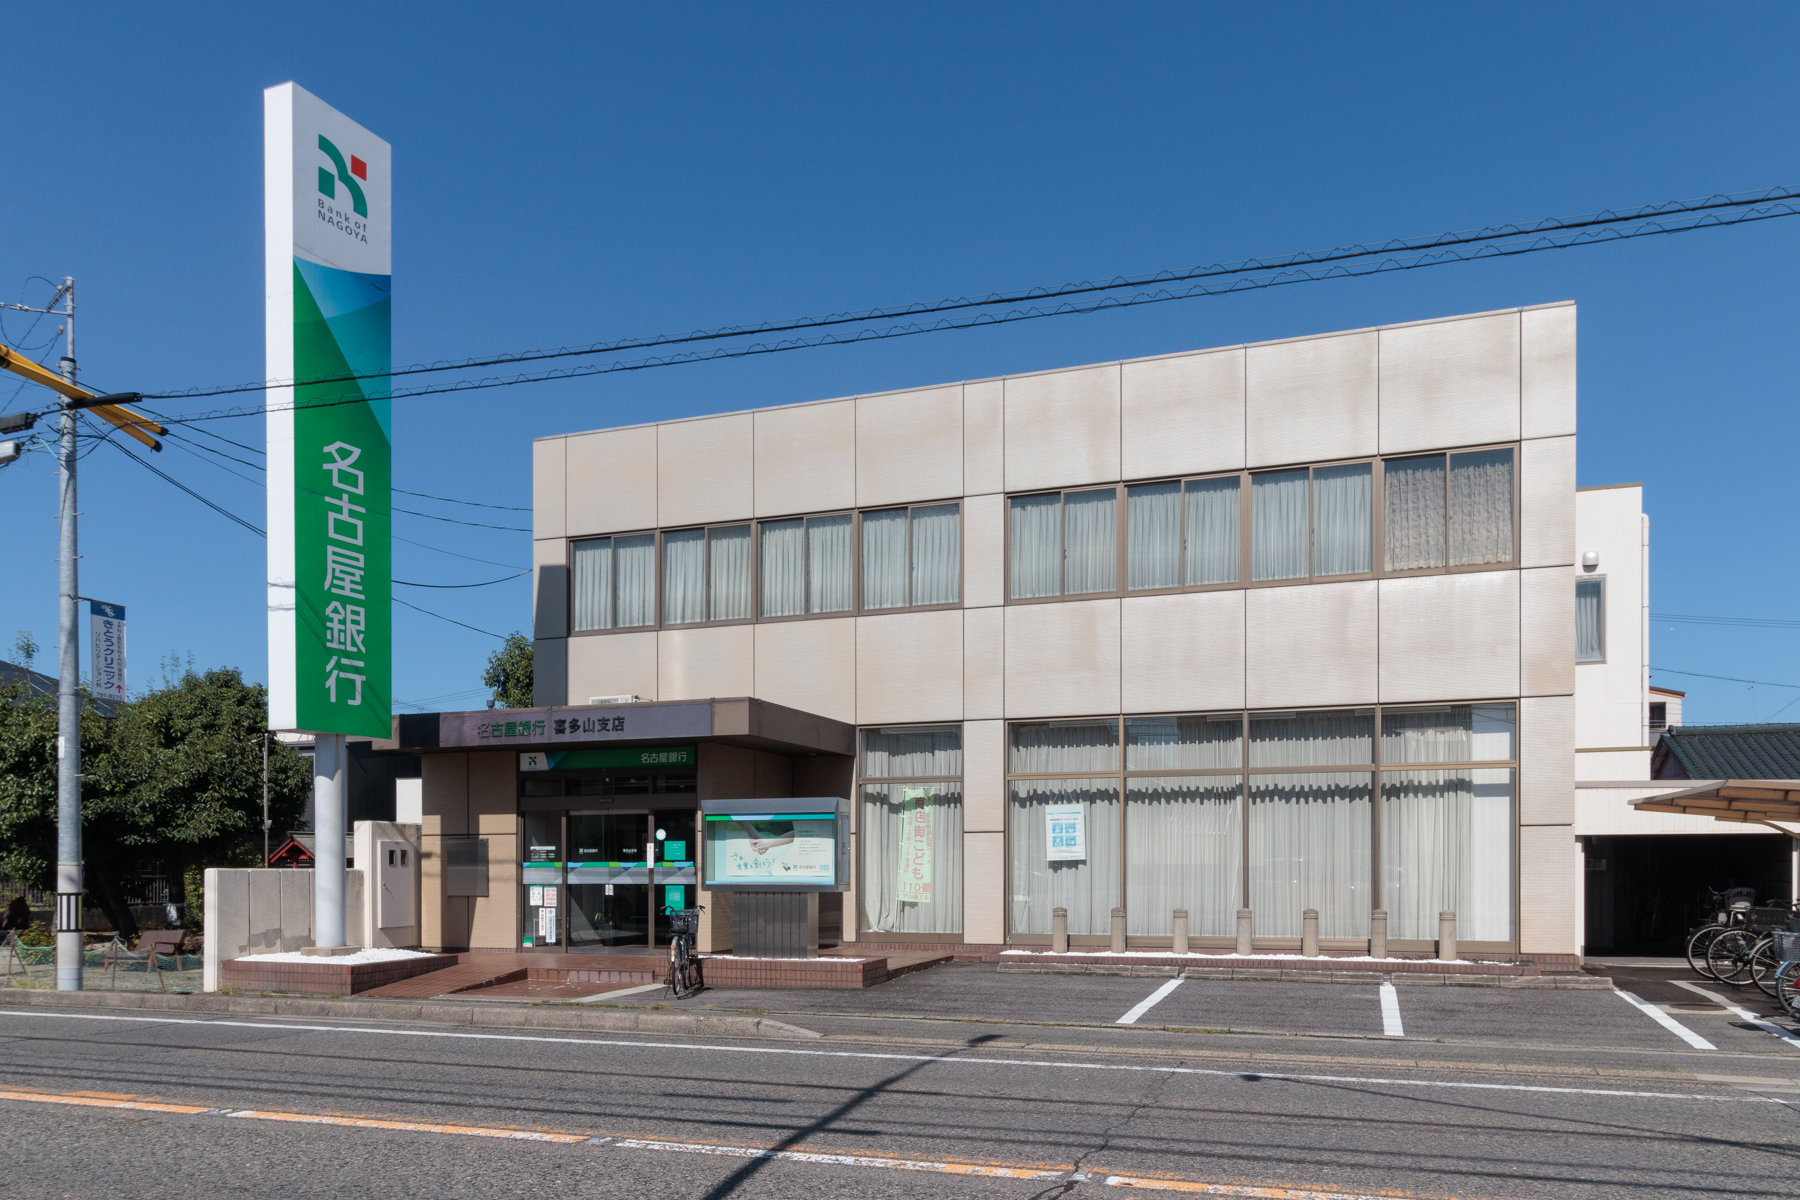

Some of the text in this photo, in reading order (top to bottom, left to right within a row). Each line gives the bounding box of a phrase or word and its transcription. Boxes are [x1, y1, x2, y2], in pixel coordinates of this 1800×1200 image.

[318, 199, 367, 233] Bank of
[318, 211, 368, 244] NAGOYA
[322, 440, 367, 706] 名古屋銀行
[477, 715, 625, 738] 名古屋銀行 喜多山支店
[640, 751, 688, 763] 名古屋銀行
[912, 797, 925, 880] 商店街こども
[902, 882, 931, 893] 110番
